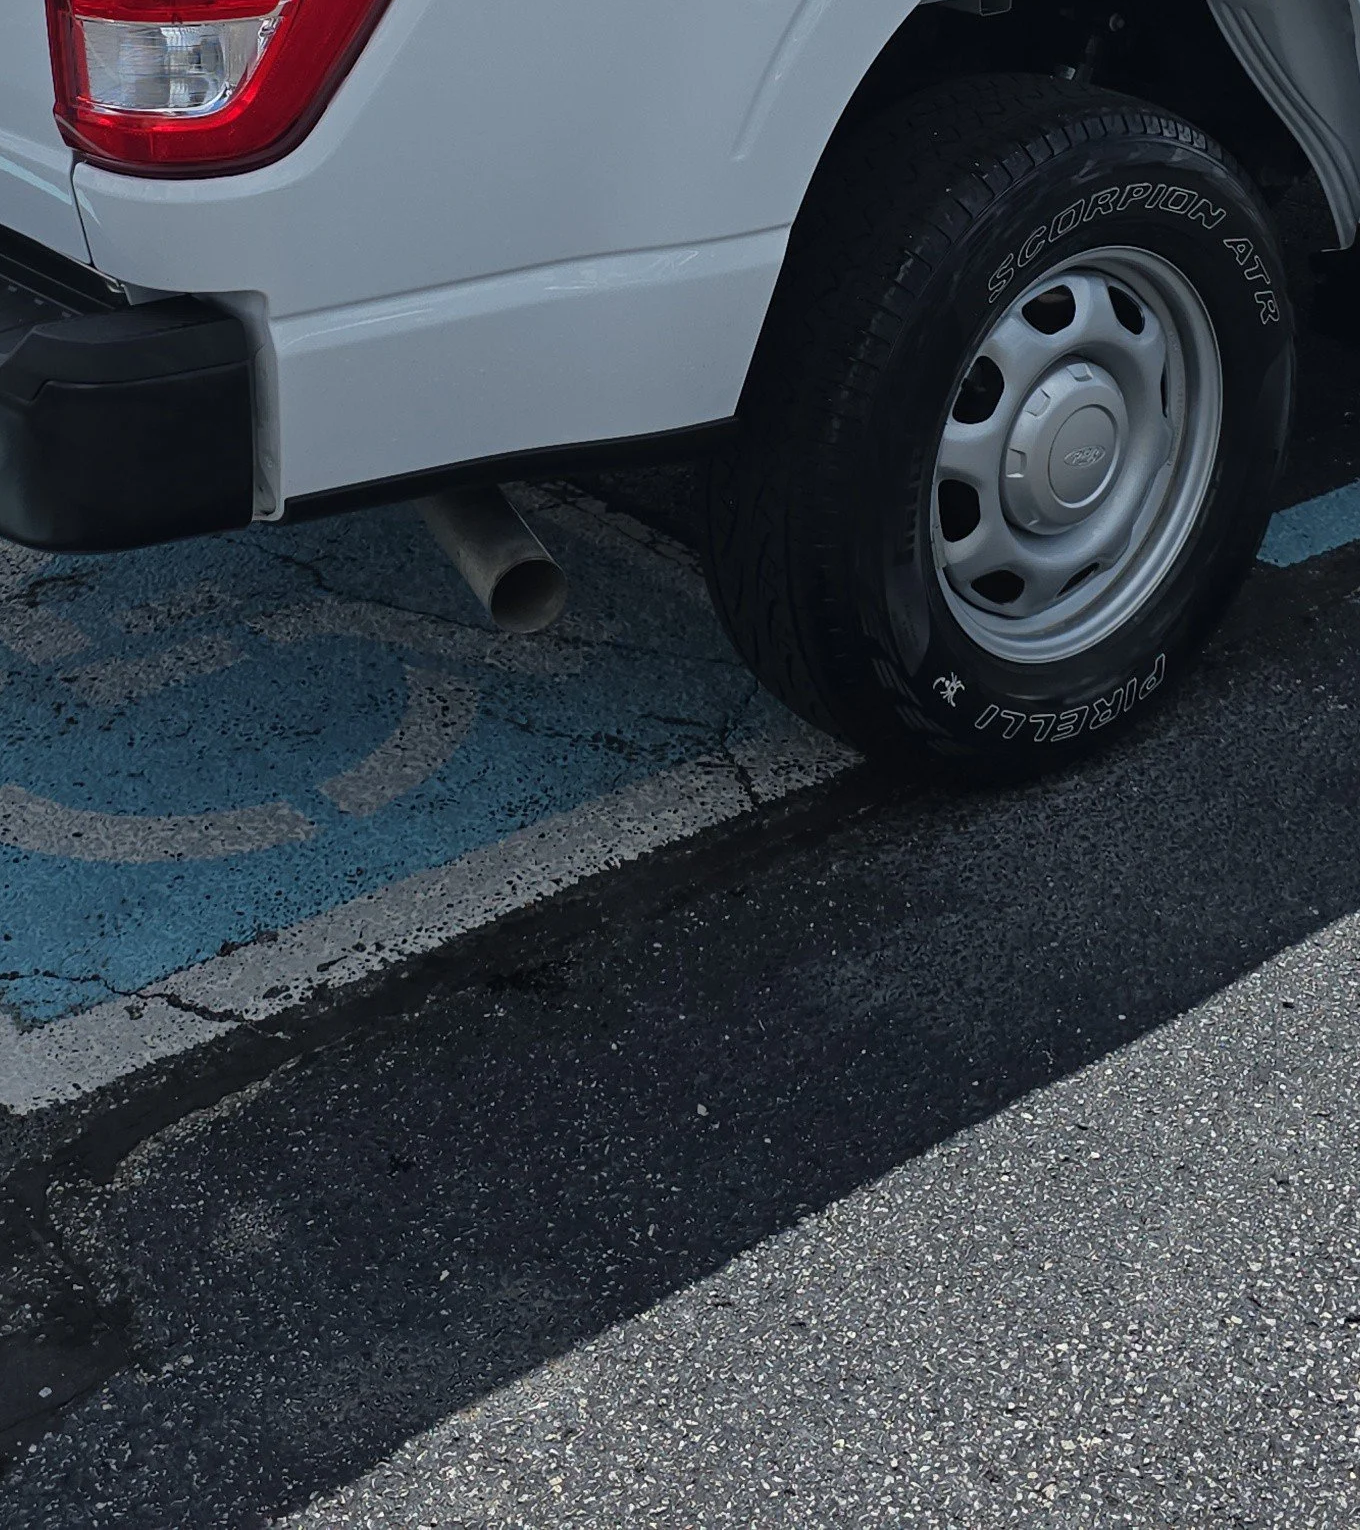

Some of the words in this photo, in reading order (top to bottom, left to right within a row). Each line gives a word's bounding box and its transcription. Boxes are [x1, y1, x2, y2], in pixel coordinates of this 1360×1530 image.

[987, 182, 1227, 304] SCORPION
[1223, 237, 1280, 326] ATR
[973, 652, 1168, 744] PIRELLI
